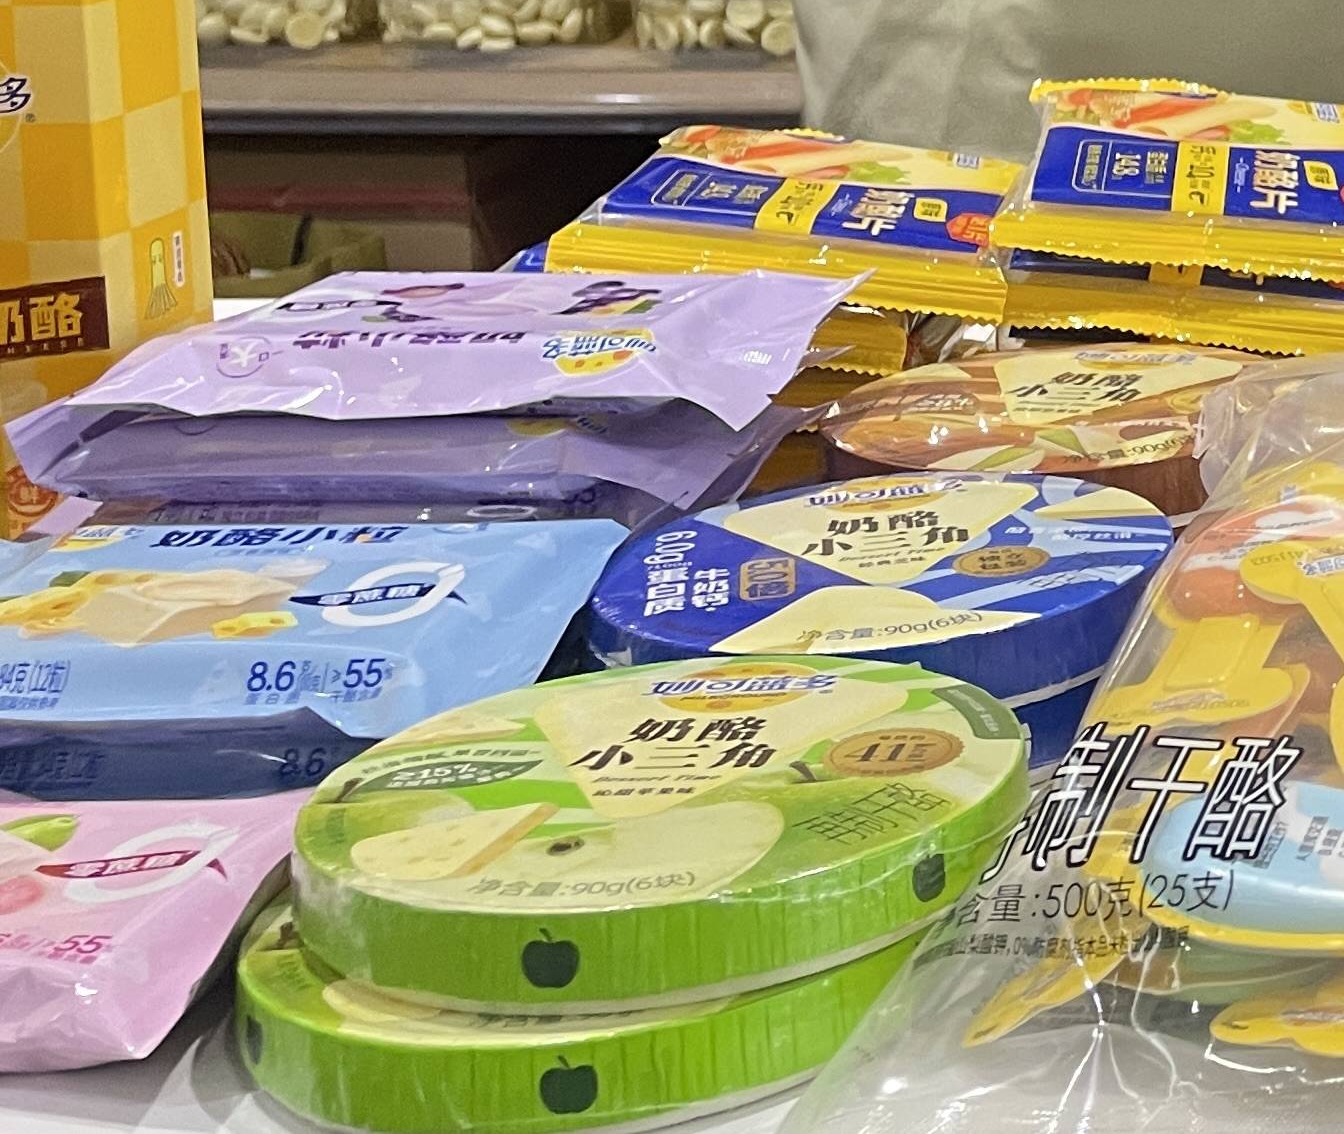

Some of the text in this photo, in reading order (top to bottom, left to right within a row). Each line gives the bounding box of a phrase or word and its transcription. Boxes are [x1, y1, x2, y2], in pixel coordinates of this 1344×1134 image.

[1005, 382, 1143, 403] 小三角
[1050, 370, 1144, 387] 奶酪
[150, 525, 411, 548] 奶酪小粒
[827, 509, 941, 536] 奶酪
[800, 524, 971, 558] 小三角
[797, 613, 984, 643] 净含量:90g(6块)
[246, 660, 297, 692] 8.6
[641, 673, 839, 697] 妙可蓝多
[623, 715, 768, 744] 奶酪
[567, 741, 778, 771] 小三角
[791, 782, 953, 846] 再制干酪
[979, 721, 1307, 885] 制干酪
[465, 869, 697, 897] 净含量:90g(6块)
